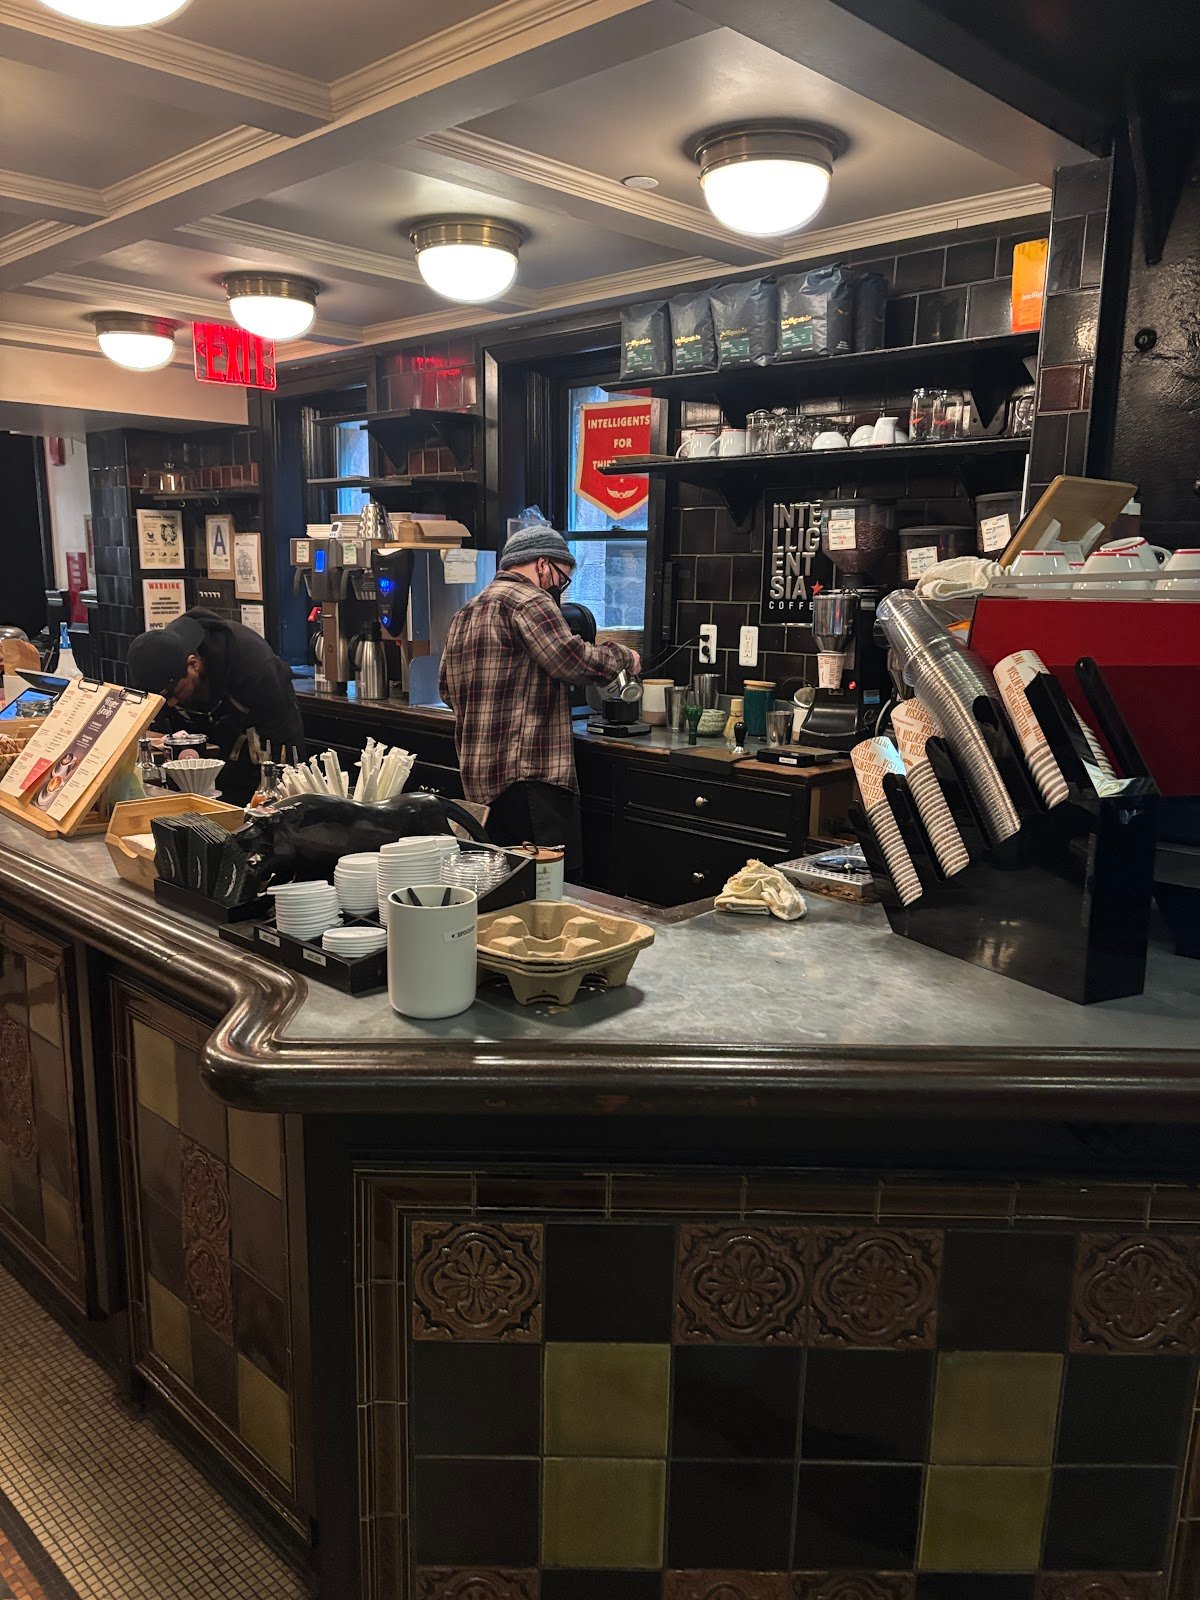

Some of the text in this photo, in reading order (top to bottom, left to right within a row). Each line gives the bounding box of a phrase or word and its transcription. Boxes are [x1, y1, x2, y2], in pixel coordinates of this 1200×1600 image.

[204, 323, 264, 385] EXIT
[587, 415, 651, 429] INTELLIGENTS
[613, 438, 632, 449] FOR
[773, 502, 821, 528] INTE
[212, 524, 227, 555] A
[771, 551, 816, 576] ENT
[148, 582, 180, 590] WARNING
[769, 575, 807, 600] SIA
[1004, 683, 1032, 740] INTELLIGENTSIA
